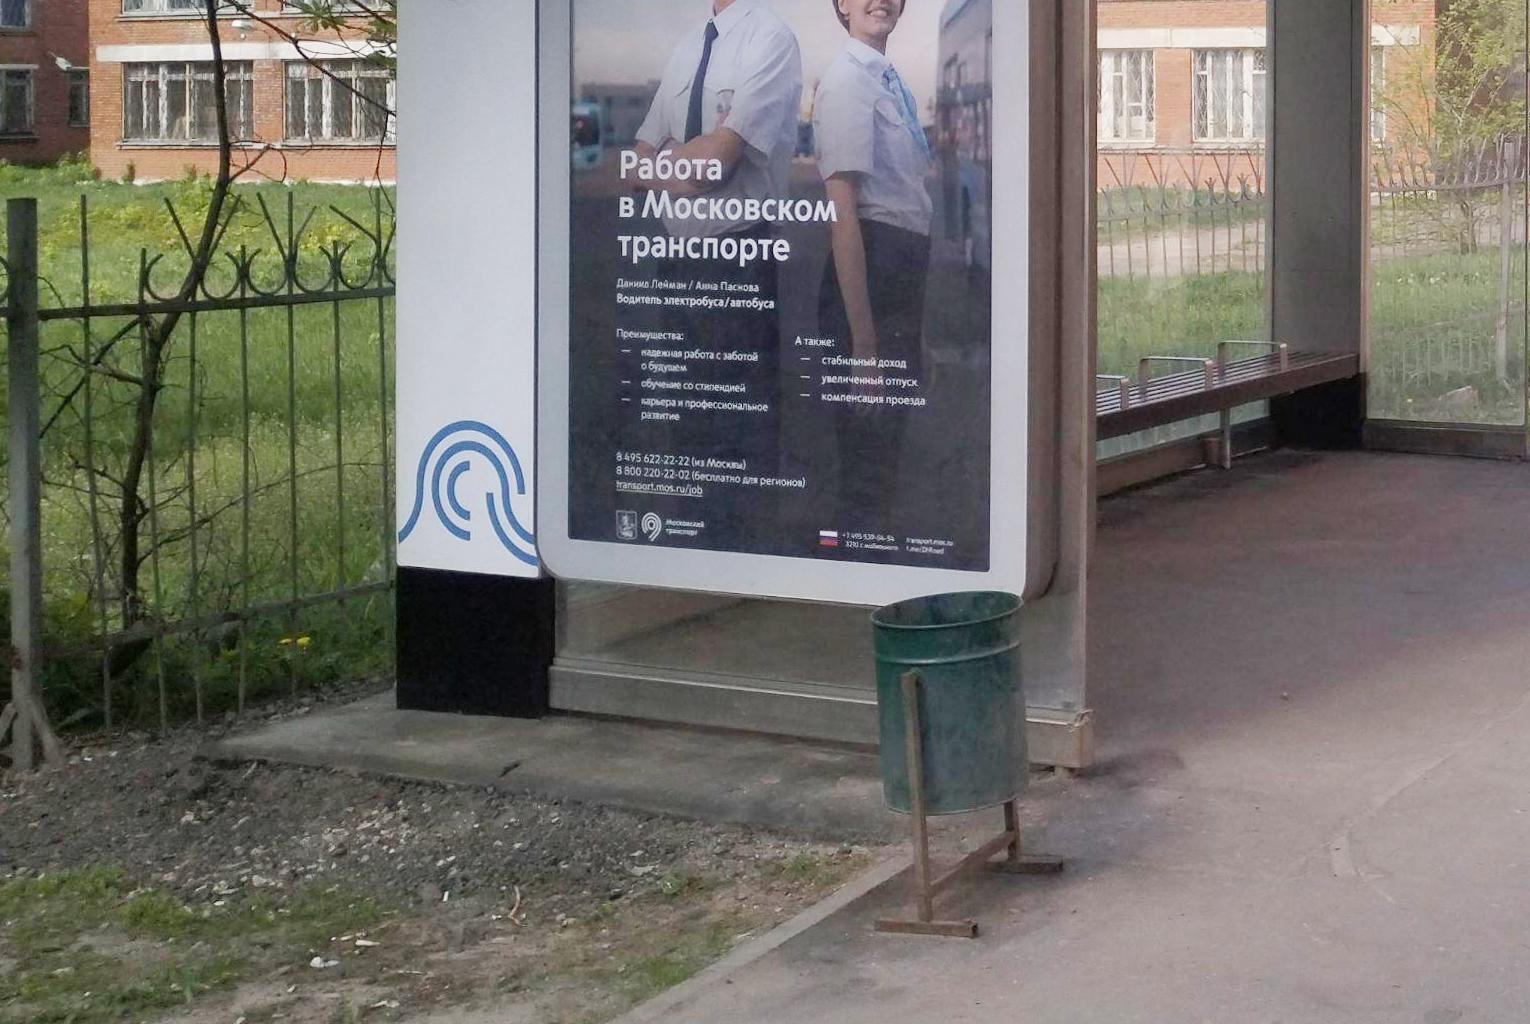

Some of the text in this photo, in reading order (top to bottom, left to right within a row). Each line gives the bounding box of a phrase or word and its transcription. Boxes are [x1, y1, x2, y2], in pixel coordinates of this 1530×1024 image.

[619, 149, 723, 181] Работа
[618, 189, 839, 223] в Московском
[617, 235, 791, 267] транспорте
[616, 293, 662, 305] Водитель
[616, 328, 684, 341] Преимущества:
[804, 338, 835, 347] также:
[640, 349, 683, 359] надежная
[684, 349, 714, 361] работа
[723, 350, 759, 362] заботой
[821, 355, 907, 370] стабильный доход
[641, 378, 746, 393] обучение со стипендией
[821, 375, 919, 388] увеличенный отпуск
[641, 398, 676, 408] карьера
[685, 399, 769, 412] профессиональное
[821, 394, 926, 407] компенсация проезда
[641, 411, 680, 422] развитие
[624, 452, 642, 463] 495
[643, 454, 690, 466] 622-22-22
[707, 458, 746, 471] Москвы)
[624, 466, 642, 476] 800
[643, 467, 690, 480] 220-22-02
[692, 469, 740, 484] (бесплатно
[742, 476, 758, 485] для
[759, 475, 806, 488] регионов)
[616, 480, 703, 496] transport.mos.ru/job
